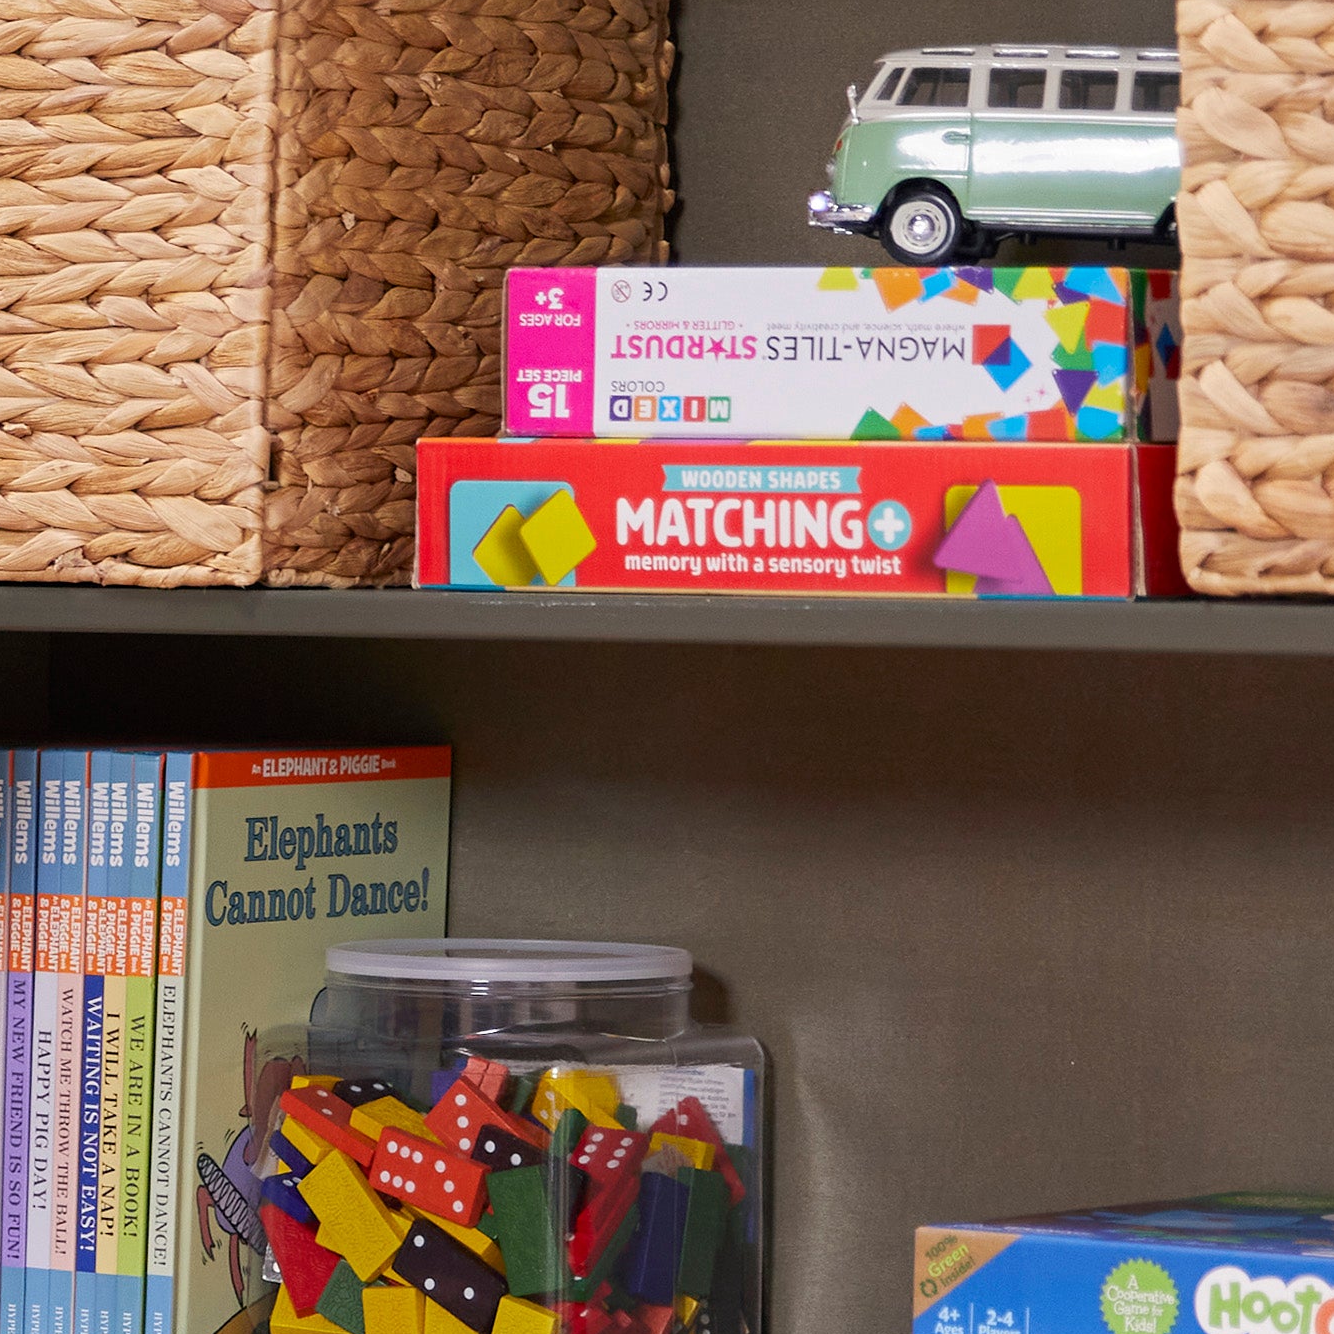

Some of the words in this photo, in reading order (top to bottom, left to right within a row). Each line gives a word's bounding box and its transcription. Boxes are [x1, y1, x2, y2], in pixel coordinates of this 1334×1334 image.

[535, 288, 564, 309] 3+
[519, 313, 556, 327] AGES
[557, 313, 581, 327] FOR
[634, 320, 679, 330] MIRRORS
[692, 320, 736, 330] GLITTER
[766, 336, 965, 361] MAGNA-TILES
[516, 369, 539, 382] SET
[544, 369, 582, 382] PIECE
[611, 380, 665, 393] COLORS
[527, 383, 570, 418] 15
[610, 397, 731, 419] MIXED
[681, 470, 762, 489] WOODEN
[768, 471, 841, 490] SHAPES
[624, 554, 701, 576] memory
[706, 553, 748, 572] with
[753, 557, 765, 573] a
[769, 557, 846, 578] sensory
[851, 556, 901, 575] twist
[263, 757, 328, 777] ELEPHANT
[329, 760, 337, 774] &
[340, 755, 380, 775] PIGGIE
[15, 780, 32, 864] Willems
[62, 780, 81, 865] Willems
[134, 783, 154, 867] Willems
[166, 781, 186, 867] Willems
[244, 813, 398, 870] Elephants
[205, 877, 317, 927] Cannot
[327, 867, 430, 917] Dance!
[13, 980, 26, 1009] MY
[60, 989, 73, 1051] WATCH
[130, 1016, 145, 1051] WE
[12, 1017, 25, 1064] NEW
[85, 996, 102, 1095] WAITING
[105, 1028, 120, 1085] WILL
[160, 985, 176, 1101] ELEPHANTS
[37, 1030, 51, 1103] HAPPY
[60, 1058, 71, 1085] ME
[128, 1059, 144, 1106] ARE
[10, 1072, 24, 1147] FRIEND
[58, 1091, 70, 1156] THROW
[84, 1103, 100, 1124] IS
[103, 1093, 118, 1155] TAKE
[127, 1115, 142, 1136] IN
[35, 1112, 49, 1148] PIG
[157, 1108, 172, 1187] CANNOT
[9, 1155, 22, 1173] IS
[83, 1132, 97, 1177] NOT
[102, 1162, 115, 1175] A
[126, 1145, 140, 1158] A
[8, 1180, 22, 1206] SO
[33, 1158, 47, 1209] DAY!
[57, 1162, 68, 1198] THE
[80, 1184, 96, 1251] EASY!
[100, 1185, 115, 1236] NAP!
[124, 1168, 140, 1237] BOOK!
[7, 1214, 21, 1259] FUN!
[55, 1204, 67, 1255] BALL!
[154, 1194, 169, 1266] DANCE!
[928, 1244, 969, 1277] Green
[1107, 1285, 1175, 1305] Cooperative
[1128, 1274, 1139, 1290] A
[938, 1307, 960, 1322] 4+
[987, 1310, 1014, 1327] 2-4
[1114, 1301, 1149, 1315] Game
[1125, 1316, 1156, 1334] Kids!
